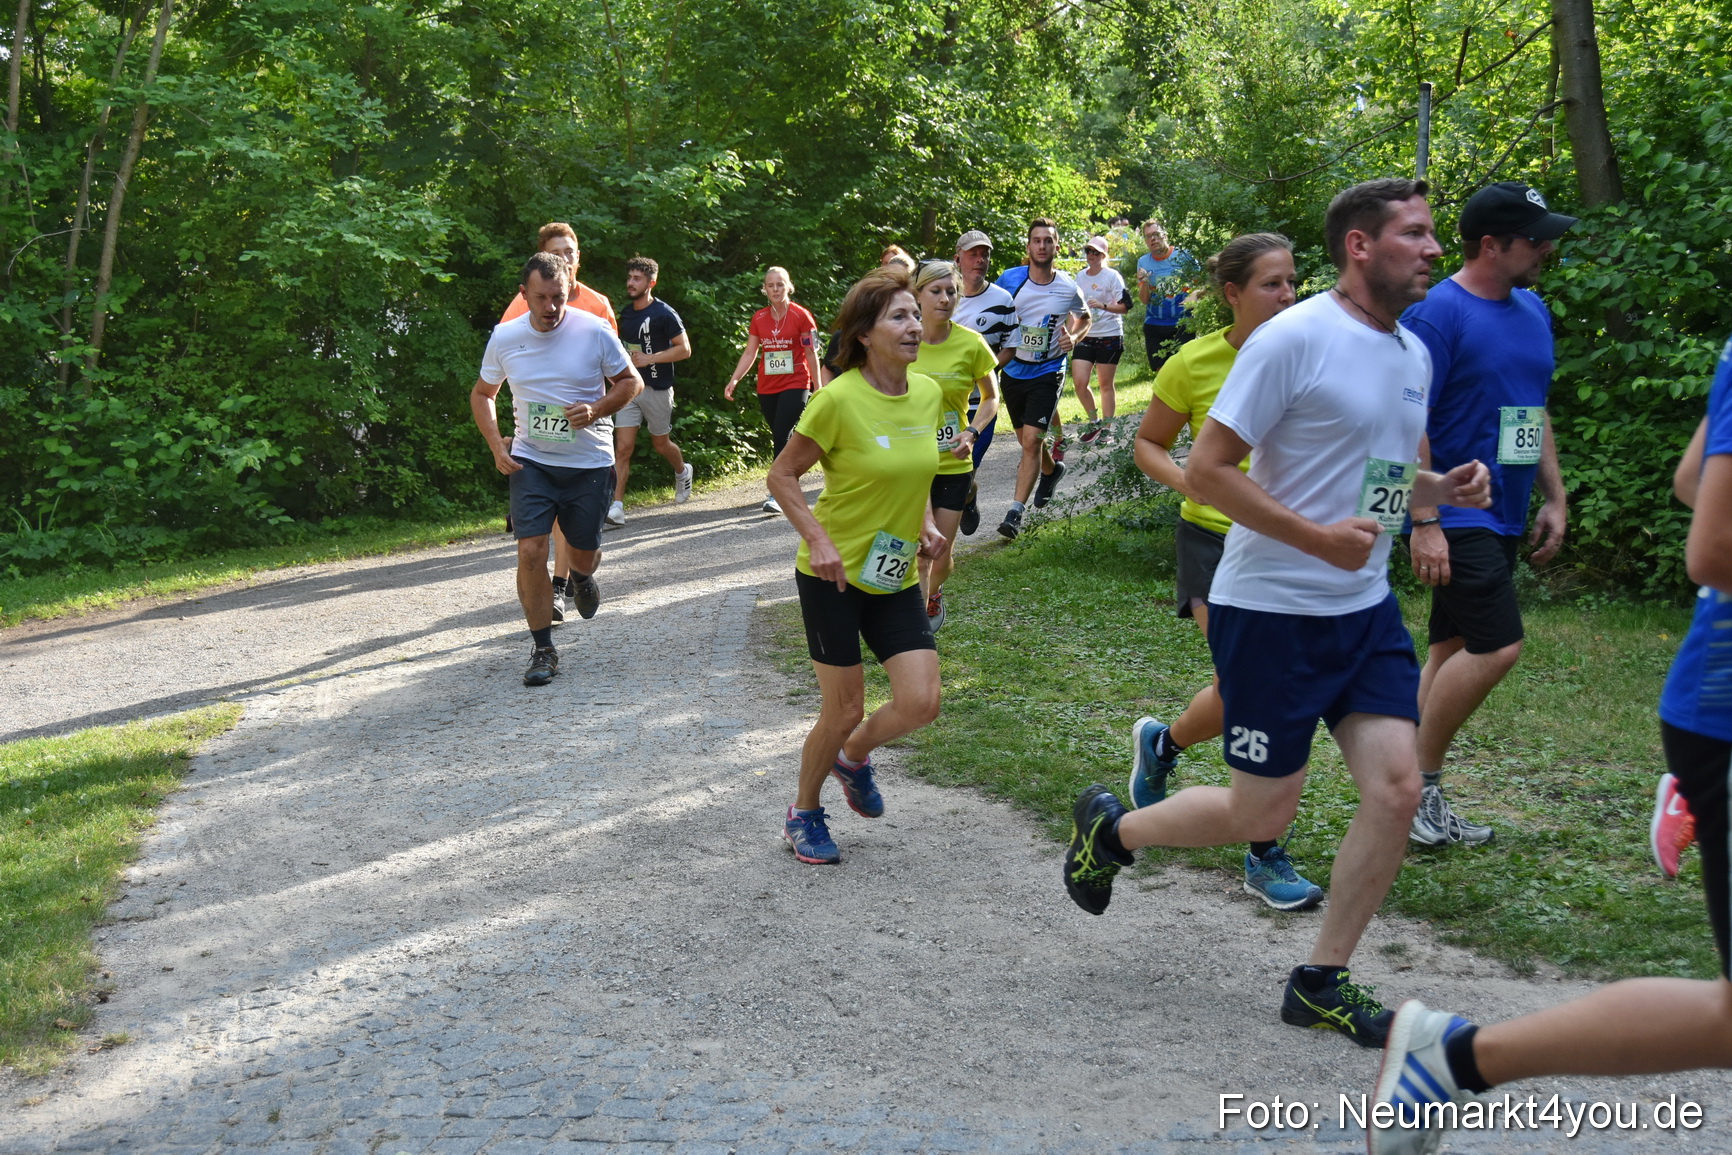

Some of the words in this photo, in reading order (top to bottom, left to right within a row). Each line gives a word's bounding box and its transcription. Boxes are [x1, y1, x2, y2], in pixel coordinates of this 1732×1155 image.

[1023, 335, 1044, 346] 053
[769, 359, 787, 369] 604
[533, 416, 569, 432] 2172
[1515, 427, 1540, 448] 850
[876, 554, 909, 579] 128
[1229, 725, 1269, 764] 26
